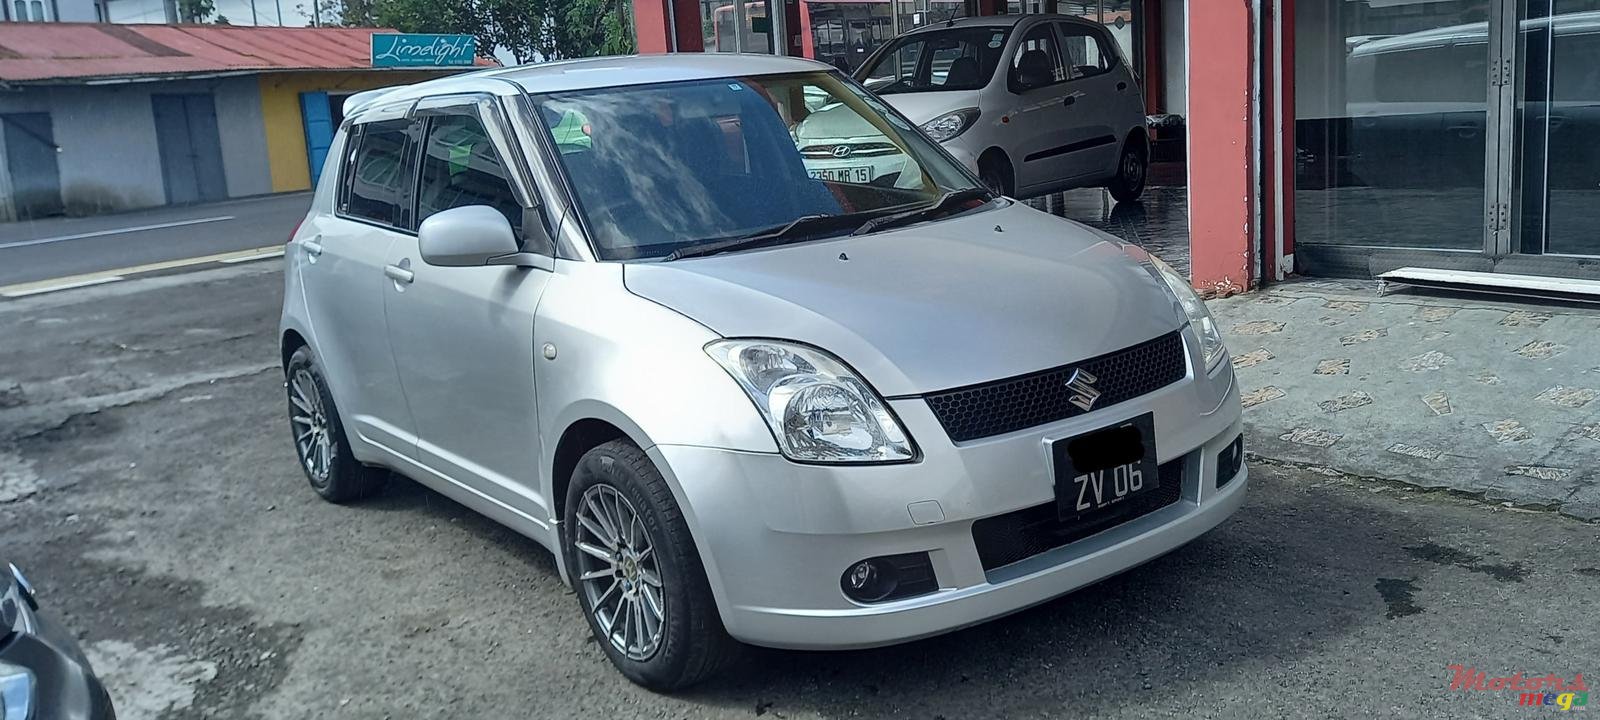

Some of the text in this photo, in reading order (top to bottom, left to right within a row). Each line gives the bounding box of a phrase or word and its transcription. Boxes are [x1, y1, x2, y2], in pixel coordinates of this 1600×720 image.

[376, 36, 472, 65] Limelight
[838, 170, 851, 183] MR
[856, 169, 867, 182] 15
[1074, 460, 1143, 511] ZV 06
